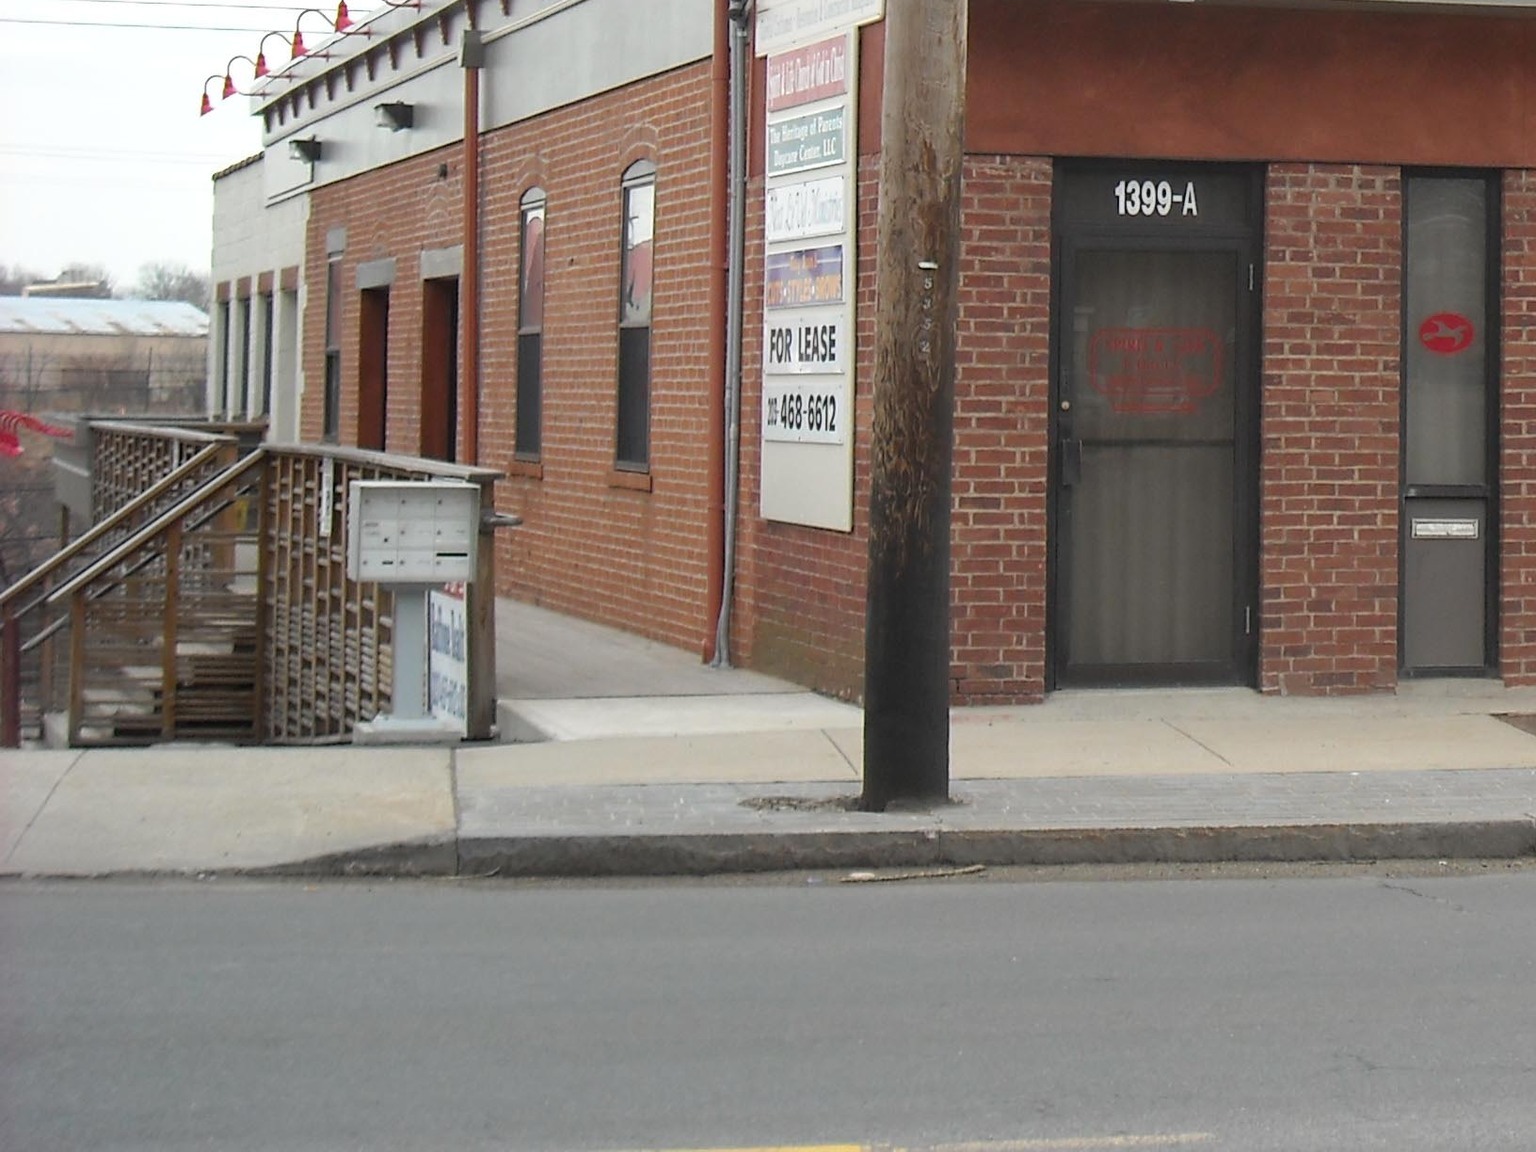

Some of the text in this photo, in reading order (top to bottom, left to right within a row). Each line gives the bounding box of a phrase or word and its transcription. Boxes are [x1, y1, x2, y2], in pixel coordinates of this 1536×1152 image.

[782, 123, 808, 141] Heritage
[810, 118, 817, 136] of
[818, 115, 842, 134] Parents
[823, 137, 836, 157] LLC
[1114, 180, 1197, 216] 1399-A
[769, 325, 836, 363] FOR LEASE
